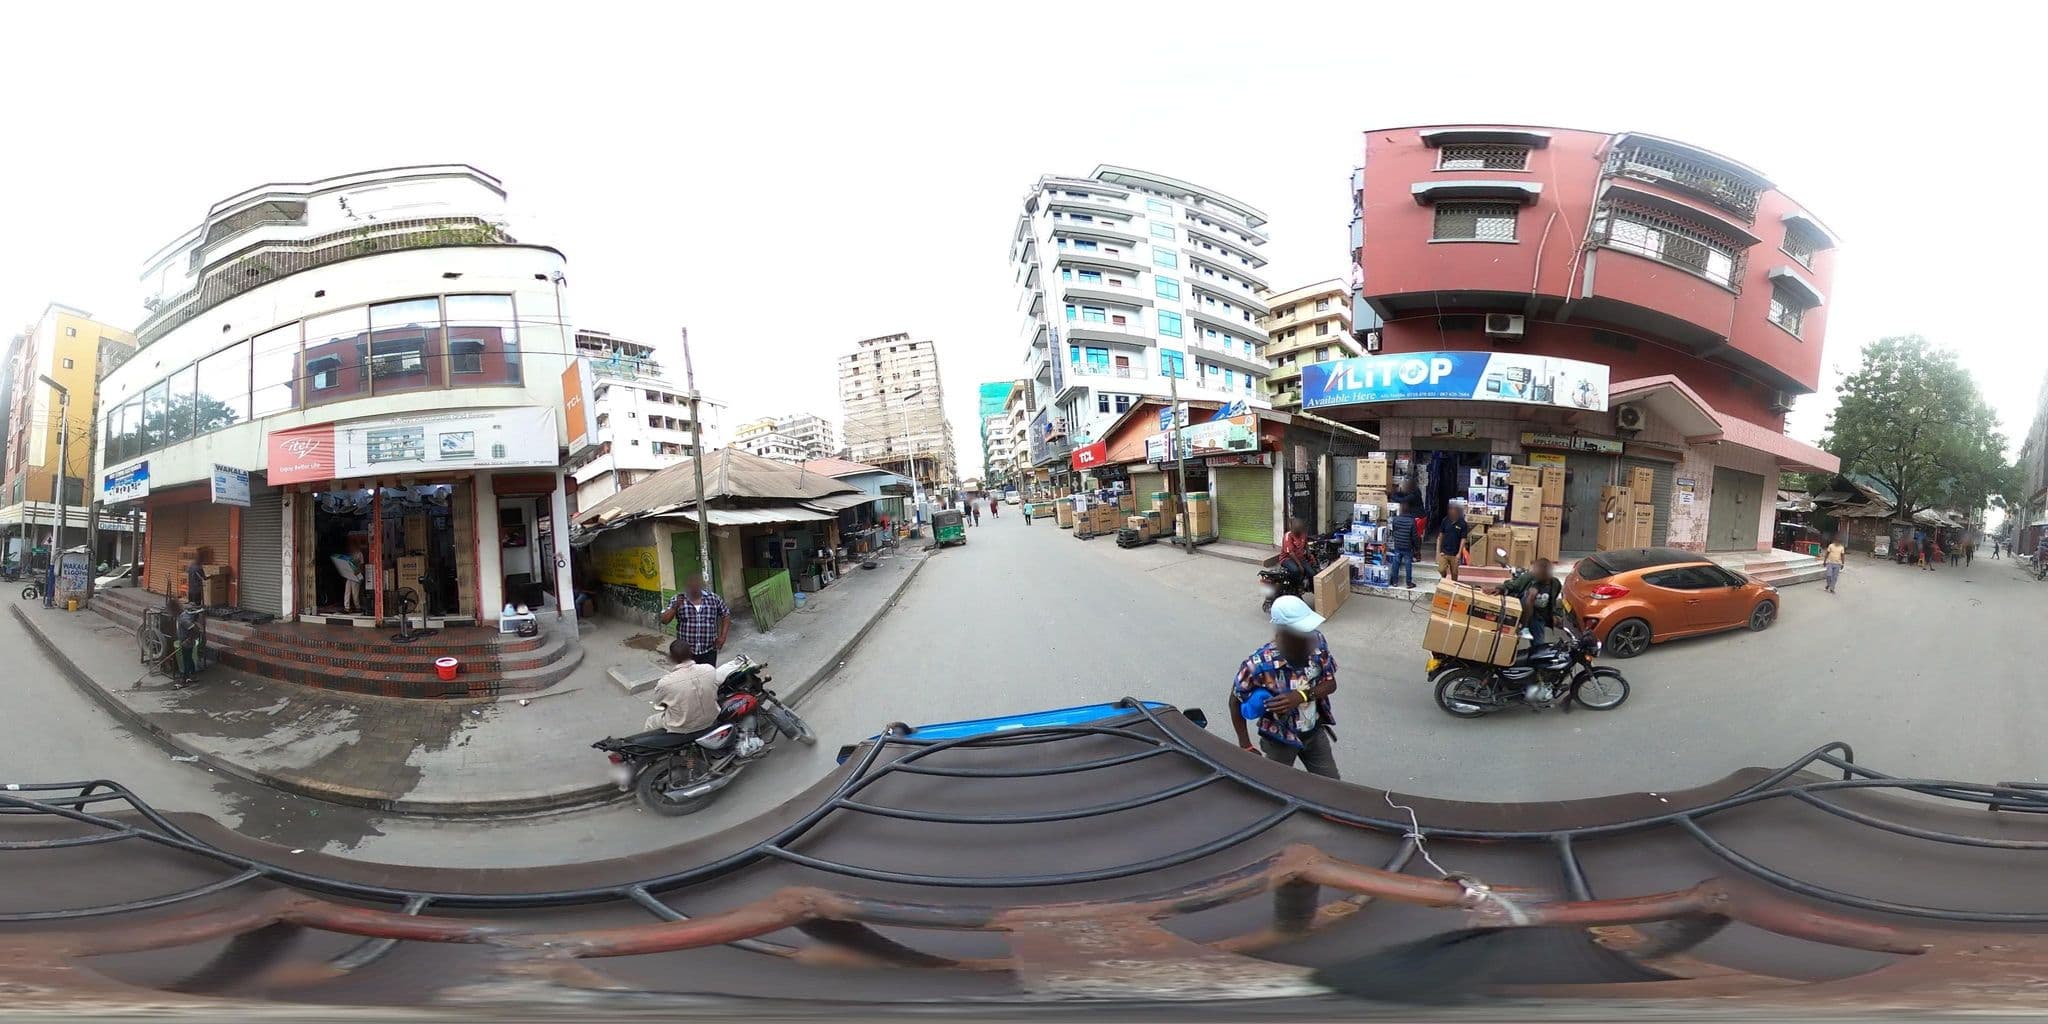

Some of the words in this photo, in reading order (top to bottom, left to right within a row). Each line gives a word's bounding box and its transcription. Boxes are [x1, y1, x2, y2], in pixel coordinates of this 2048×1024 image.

[566, 395, 581, 411] TCL
[1306, 394, 1352, 407] Available
[1353, 391, 1376, 401] Here
[1079, 450, 1095, 463] TCL
[215, 464, 249, 477] WAKALA
[63, 562, 88, 571] WAKALA
